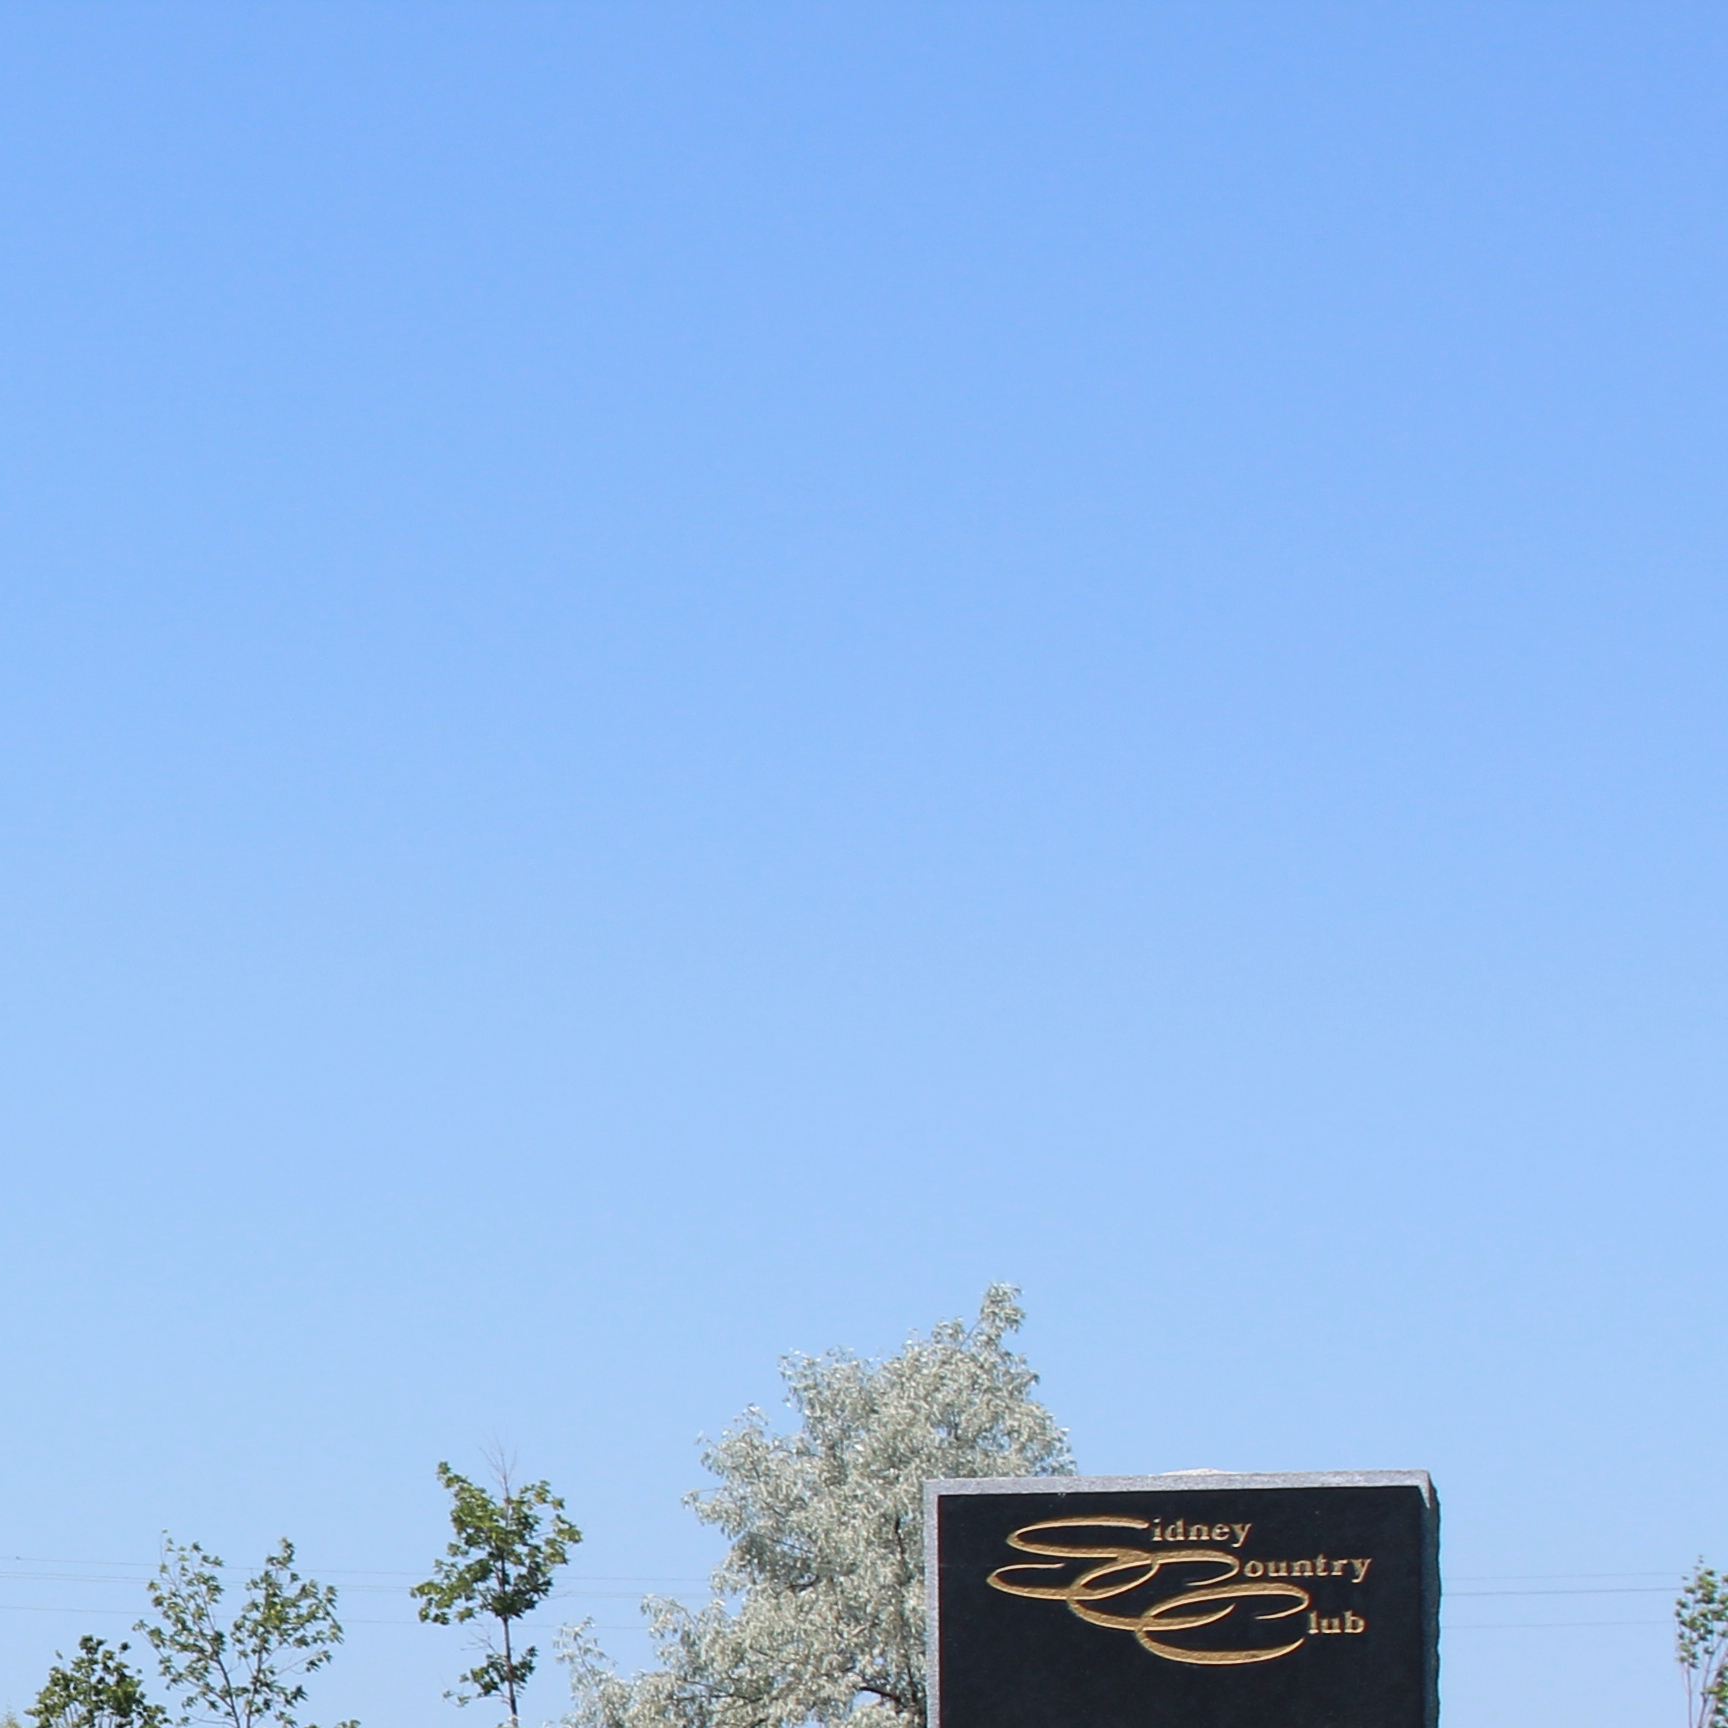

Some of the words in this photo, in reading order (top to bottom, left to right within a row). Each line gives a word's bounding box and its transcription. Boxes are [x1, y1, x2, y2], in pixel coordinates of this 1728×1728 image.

[986, 1515, 1252, 1600] Sidney
[1066, 1549, 1372, 1631] Country
[1135, 1581, 1366, 1665] Club
